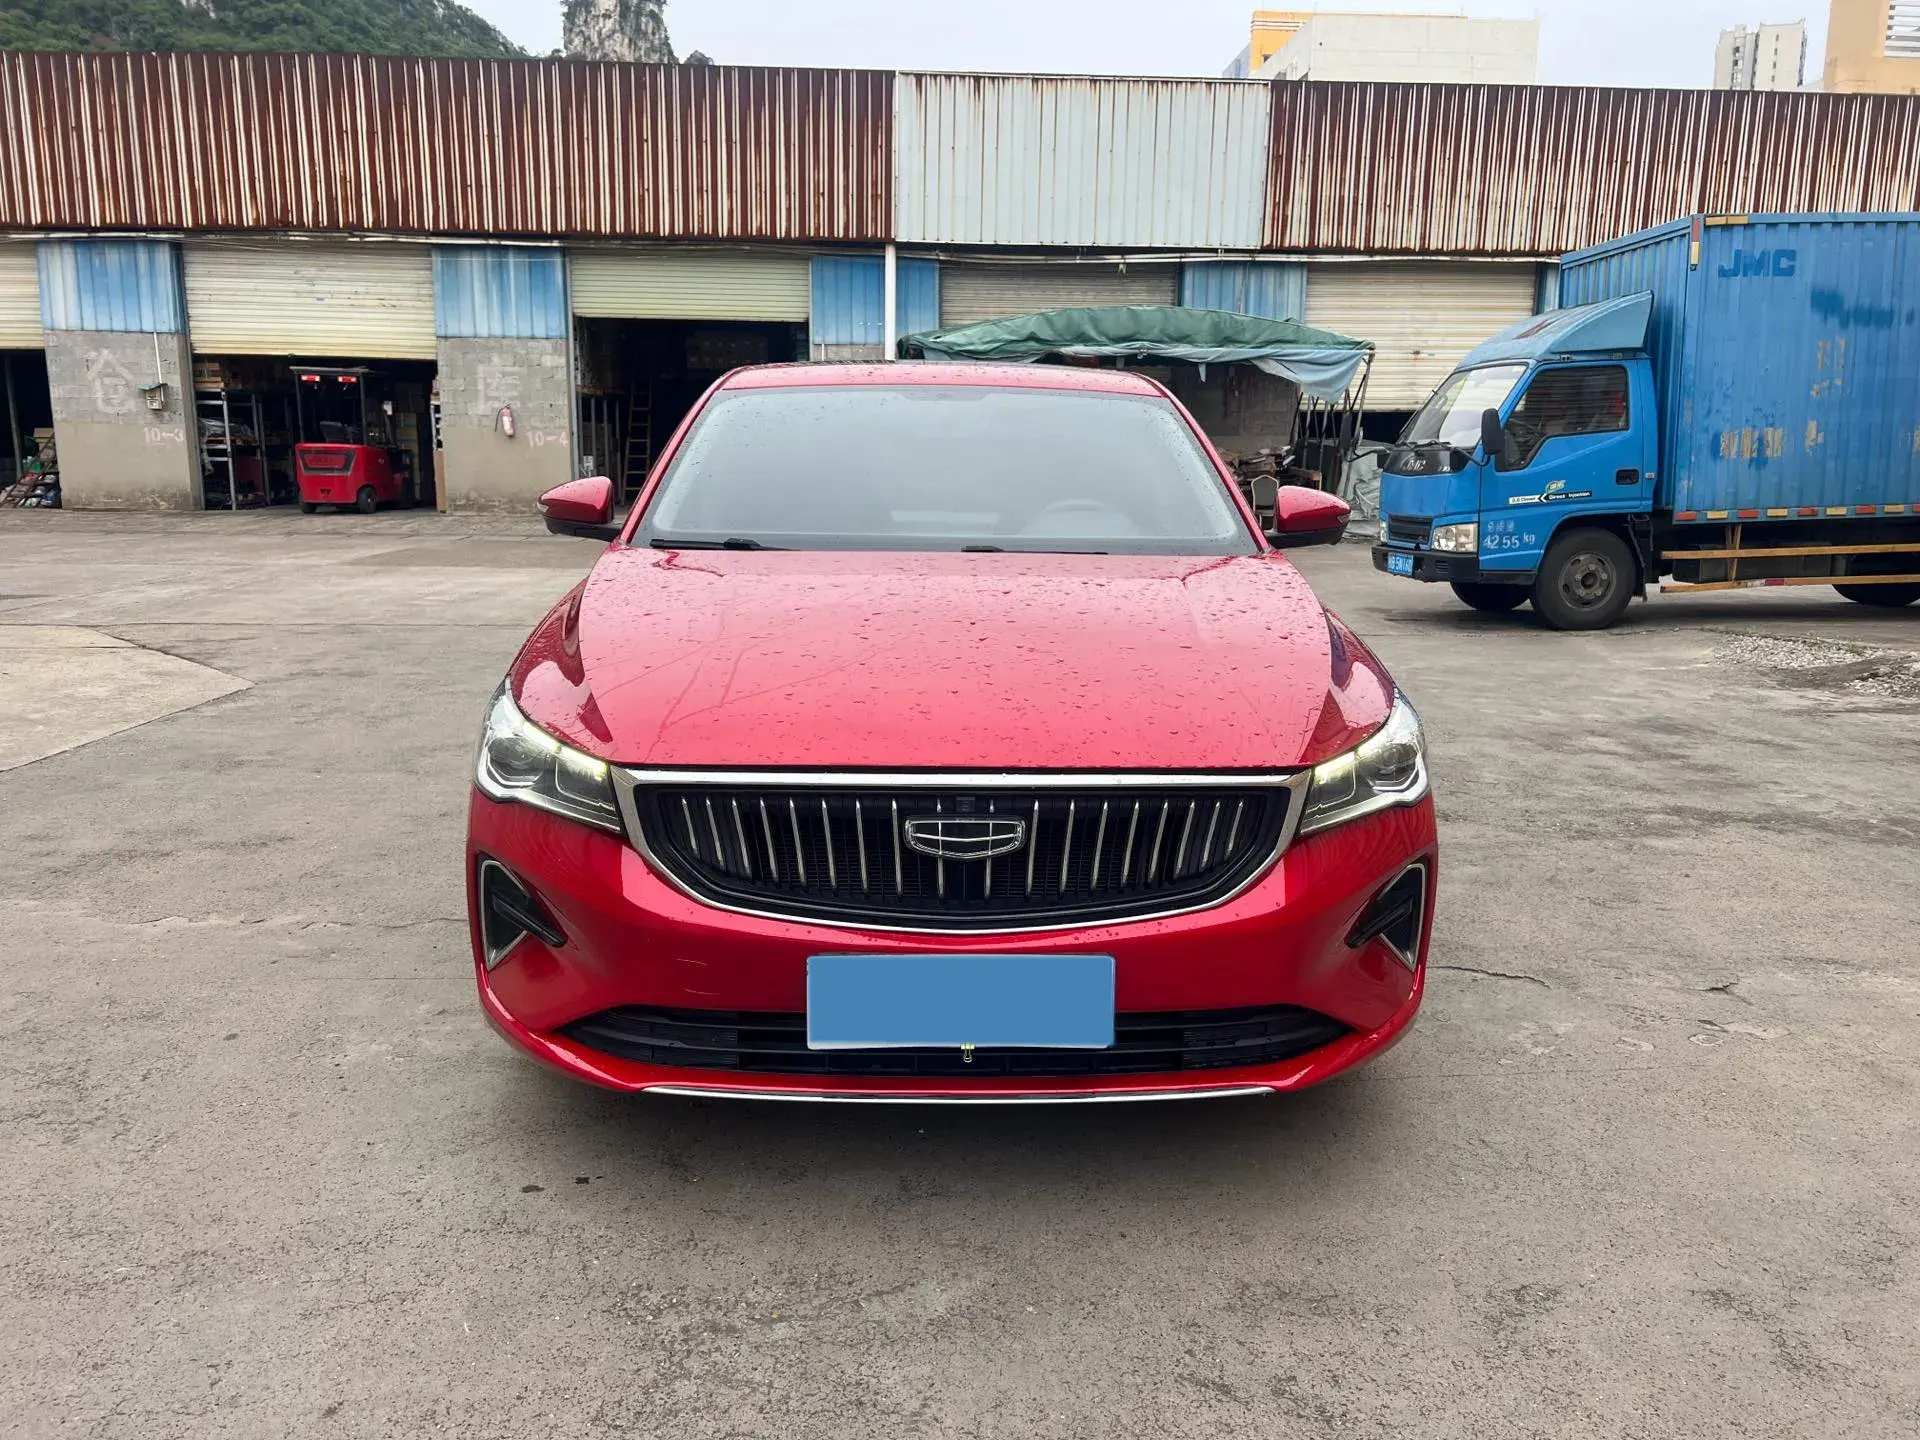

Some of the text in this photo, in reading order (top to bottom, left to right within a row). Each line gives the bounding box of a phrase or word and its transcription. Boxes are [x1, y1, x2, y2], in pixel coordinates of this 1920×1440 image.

[1718, 249, 1797, 278] JMC
[143, 426, 184, 444] 10-3
[525, 430, 569, 448] 10-4
[1523, 532, 1536, 545] kg
